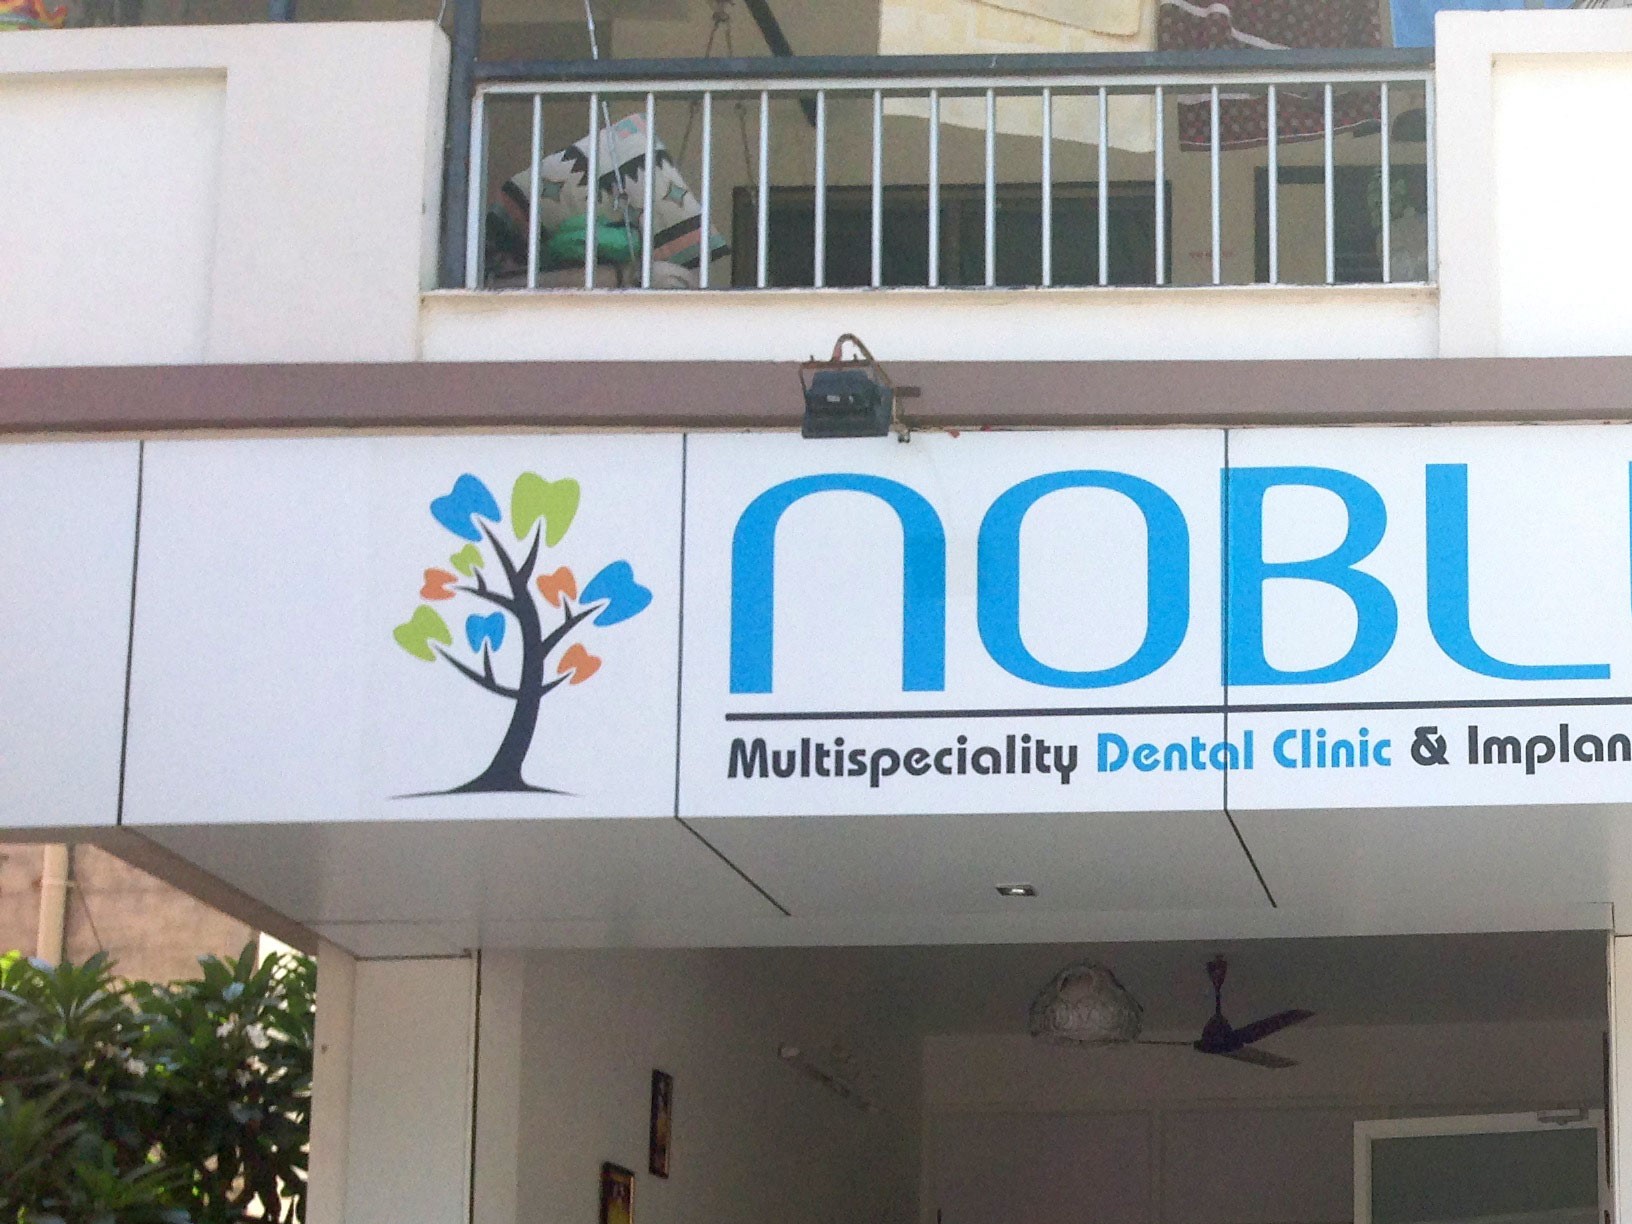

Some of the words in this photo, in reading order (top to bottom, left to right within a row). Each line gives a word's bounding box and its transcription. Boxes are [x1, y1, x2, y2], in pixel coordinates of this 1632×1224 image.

[727, 733, 1078, 788] Multispeciality
[1097, 730, 1253, 772] Dental
[1273, 727, 1392, 769] Clinic
[1410, 725, 1450, 765] &
